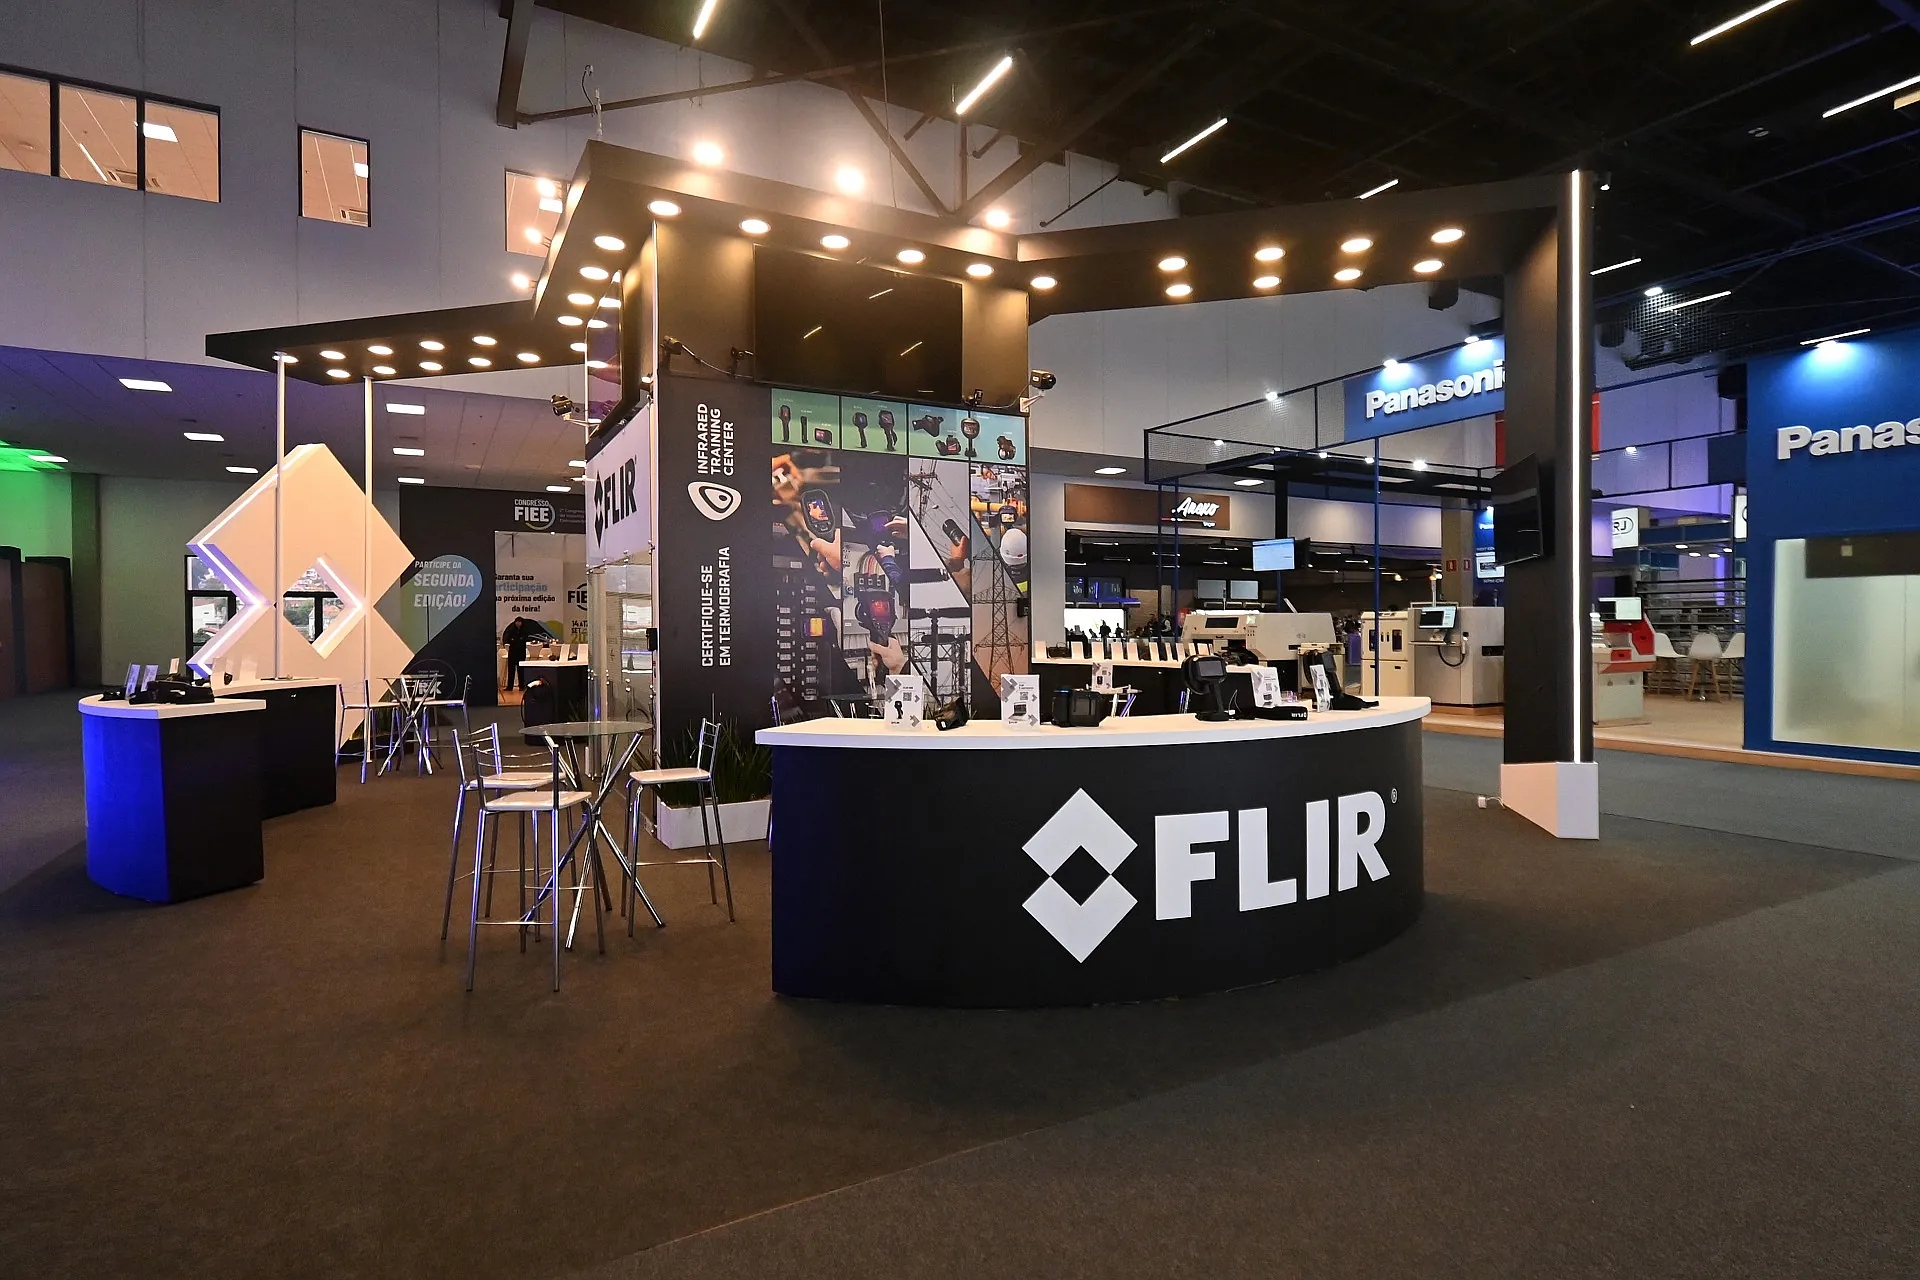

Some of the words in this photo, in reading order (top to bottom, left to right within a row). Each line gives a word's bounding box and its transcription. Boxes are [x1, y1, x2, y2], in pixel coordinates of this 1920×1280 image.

[1366, 359, 1506, 419] Panasoni
[697, 403, 708, 474] INFRARED
[710, 408, 721, 475] TRAINING
[723, 421, 734, 476] CENTER
[514, 499, 549, 507] CONGRESSO
[514, 506, 550, 522] FIEE
[604, 457, 638, 530] FLIR
[414, 560, 451, 569] PARTICIPE
[452, 561, 462, 569] DA
[414, 573, 475, 588] SEGUNDA
[414, 591, 467, 610] EDIÇÃO!
[701, 565, 715, 667] CERTIFIQUE-SE
[718, 546, 731, 644] TERMOGRAFIA
[719, 646, 731, 666] EM
[1154, 790, 1391, 921] FLIR
